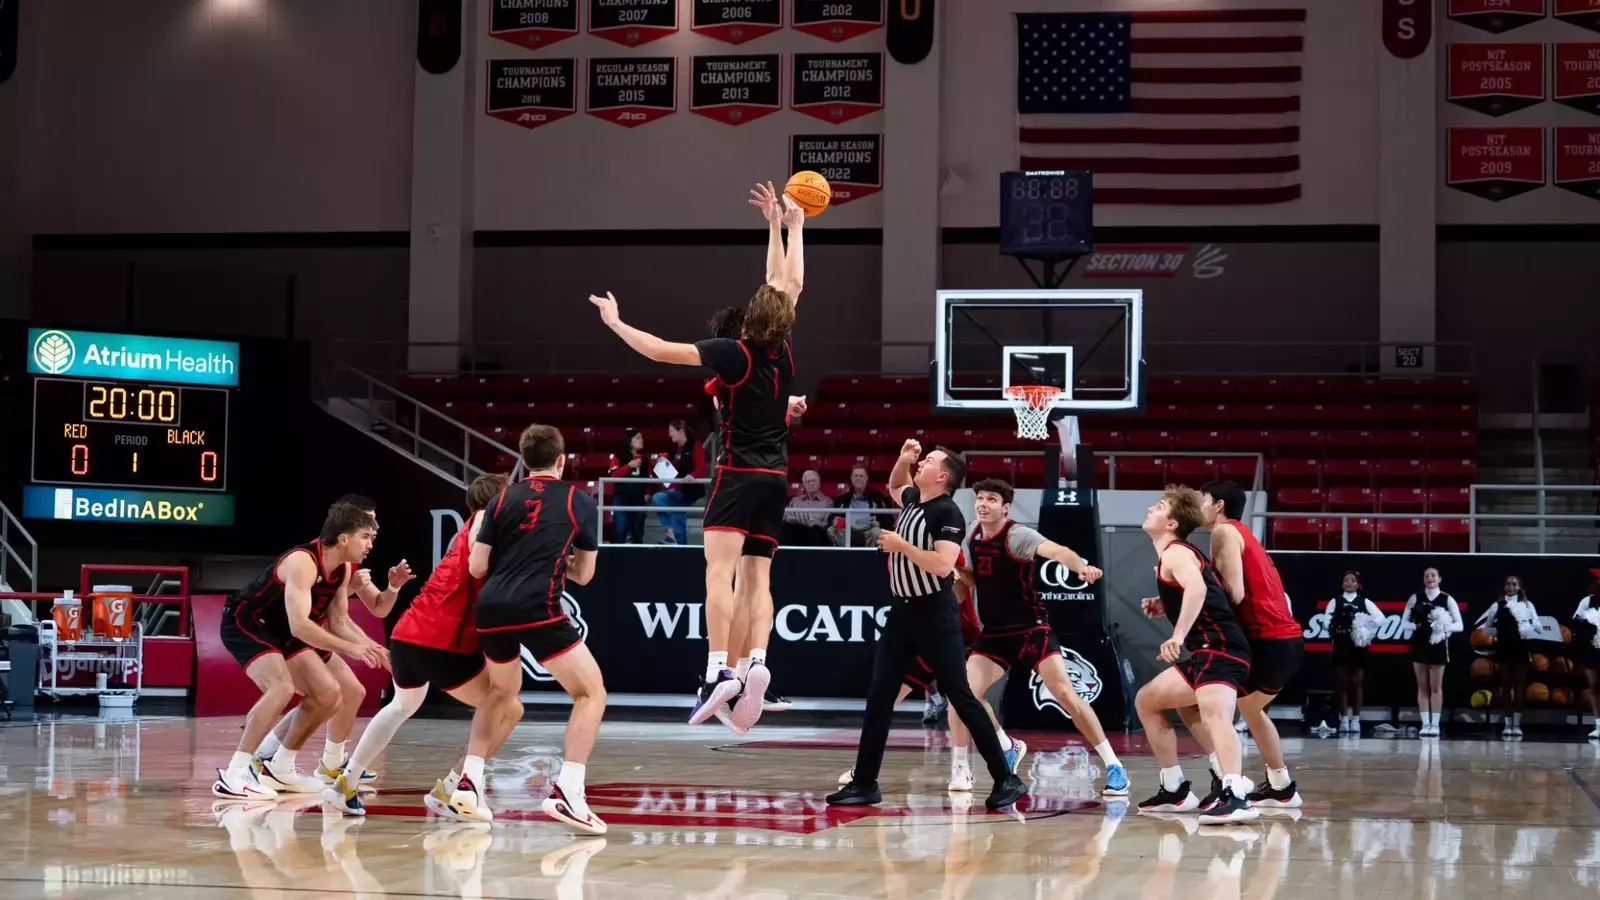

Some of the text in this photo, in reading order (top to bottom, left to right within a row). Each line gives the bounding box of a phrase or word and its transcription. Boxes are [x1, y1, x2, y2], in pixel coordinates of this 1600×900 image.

[500, 0, 569, 9] CHAMPIONS
[822, 4, 852, 16] 2002
[520, 12, 549, 24] 2008
[618, 9, 648, 22] 2007
[722, 6, 752, 19] 2006
[596, 63, 670, 74] REGULAR SEASON
[706, 60, 767, 71] TOURNAMENT
[807, 58, 869, 69] TOURNAMENT
[1461, 60, 1531, 72] POSTSEASON
[502, 66, 562, 76] TOURNAMENT
[802, 69, 873, 82] CHAMPIONS
[496, 77, 566, 89] CHAMPIONS
[597, 74, 667, 86] CHAMPIONS
[700, 71, 771, 84] CHAMPIONS
[1480, 77, 1512, 89] 2005
[618, 90, 645, 101] 2015
[721, 88, 750, 99] 2013
[823, 86, 851, 98] 2012
[799, 141, 874, 151] REGULAR SEASON
[1461, 145, 1531, 156] POSTSEASON
[800, 151, 872, 163] CHAMPIONS
[820, 168, 851, 179] 2022
[1086, 253, 1184, 270] SECTION 30
[1397, 347, 1420, 356] SECT
[83, 344, 234, 374] Atrium Health
[90, 386, 175, 421] 20:00
[64, 424, 88, 439] RED
[167, 429, 205, 445] BLACK
[115, 435, 148, 446] PERIOD
[72, 444, 88, 474] 0
[132, 452, 137, 473] 1
[201, 451, 217, 481] 0
[76, 497, 198, 521] BedInABox
[519, 499, 543, 531] 3
[632, 602, 892, 642] WICAT
